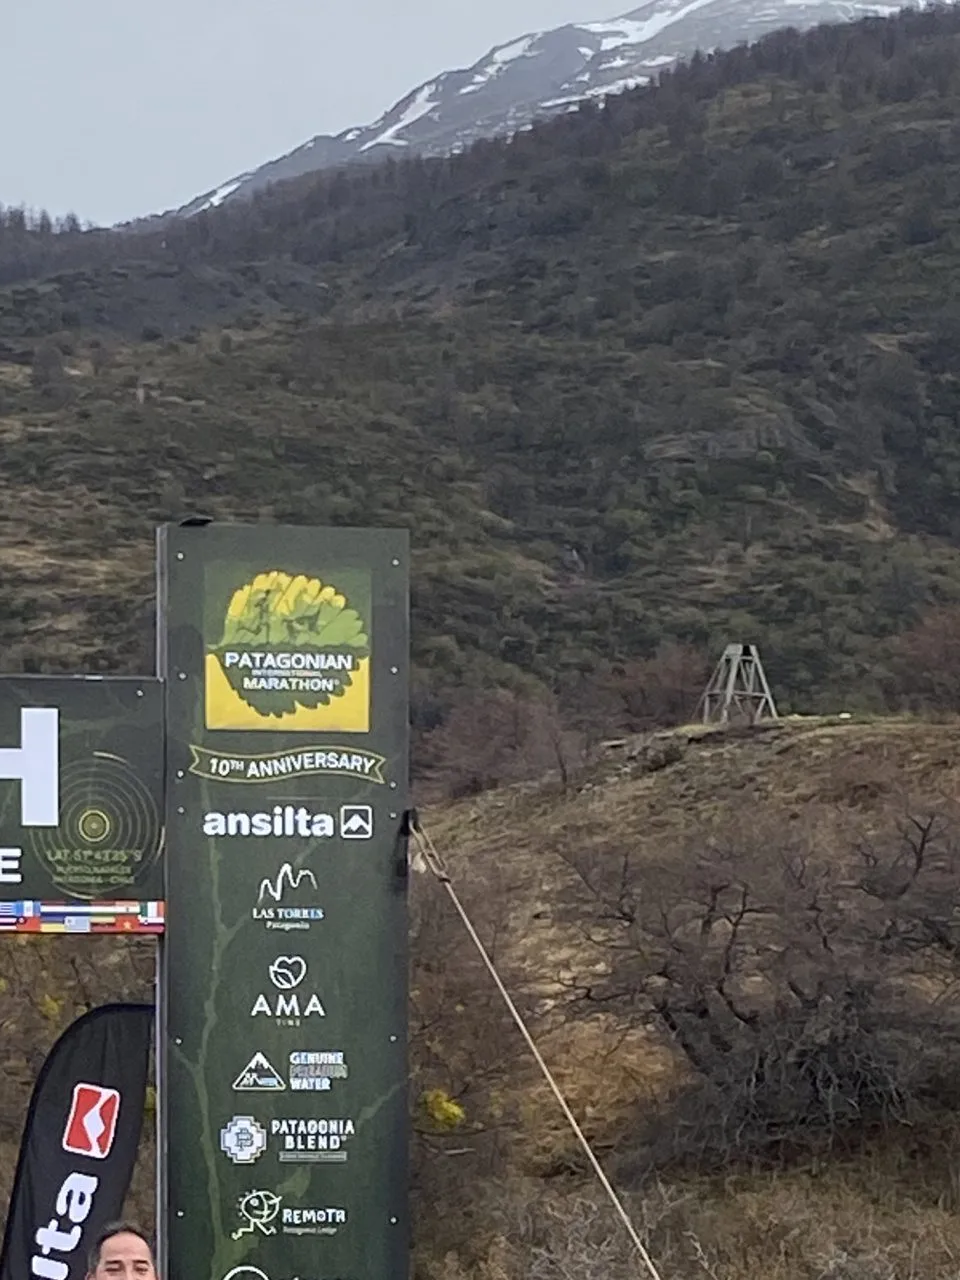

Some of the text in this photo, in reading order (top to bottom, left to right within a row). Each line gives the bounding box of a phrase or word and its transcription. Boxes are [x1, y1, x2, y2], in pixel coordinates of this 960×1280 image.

[225, 652, 353, 670] PATAGONIAN
[209, 752, 376, 779] 10TH ANNIVERSARY
[202, 806, 335, 837] ansilta
[252, 907, 325, 919] LAS TORRES
[251, 994, 326, 1017] AMA
[290, 1077, 331, 1091] WATER
[271, 1119, 355, 1135] PATAGONIA
[282, 1208, 346, 1224] REMOTA
